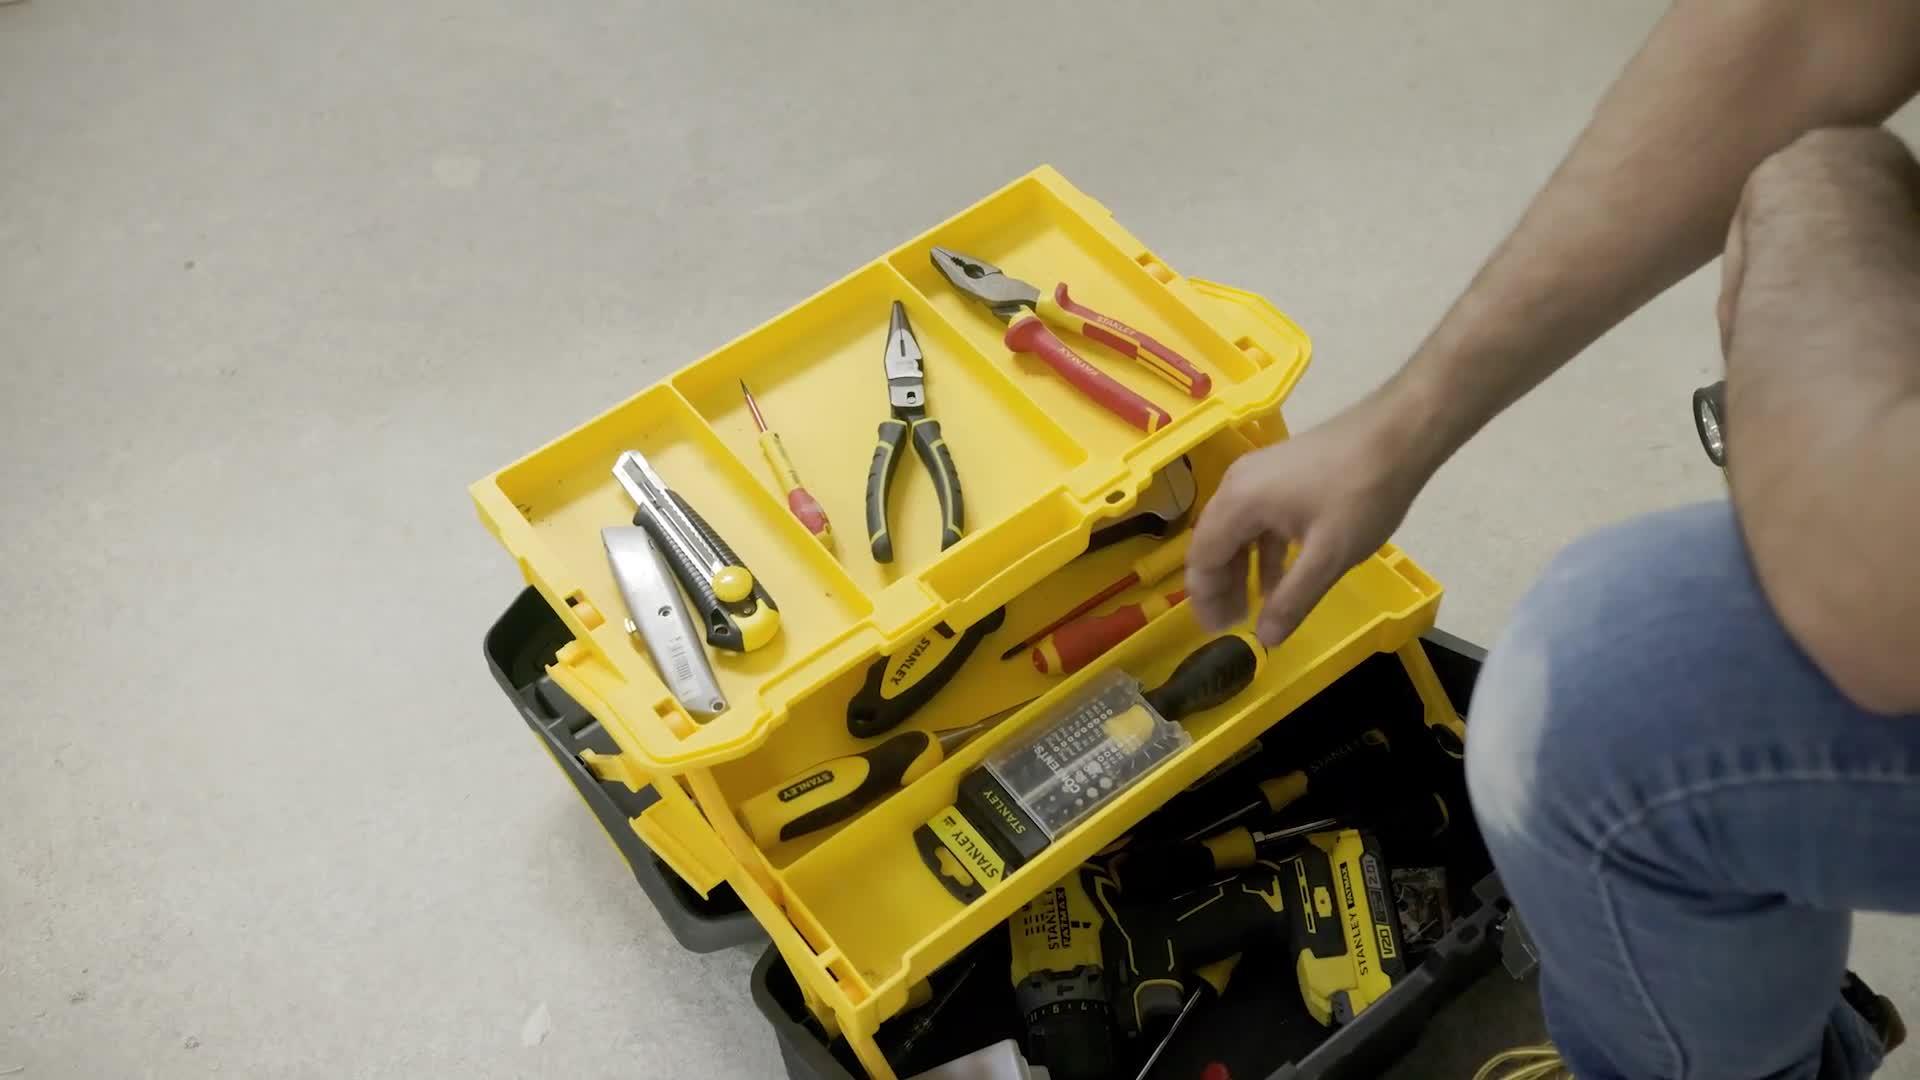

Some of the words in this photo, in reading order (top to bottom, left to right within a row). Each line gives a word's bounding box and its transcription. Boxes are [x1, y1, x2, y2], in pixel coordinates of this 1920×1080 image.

[891, 636, 931, 686] STANLEY
[783, 773, 832, 799] STANLEY
[983, 790, 1026, 835] STANLEY
[951, 830, 1000, 878] STANLEY
[1348, 913, 1368, 976] STANLEY
